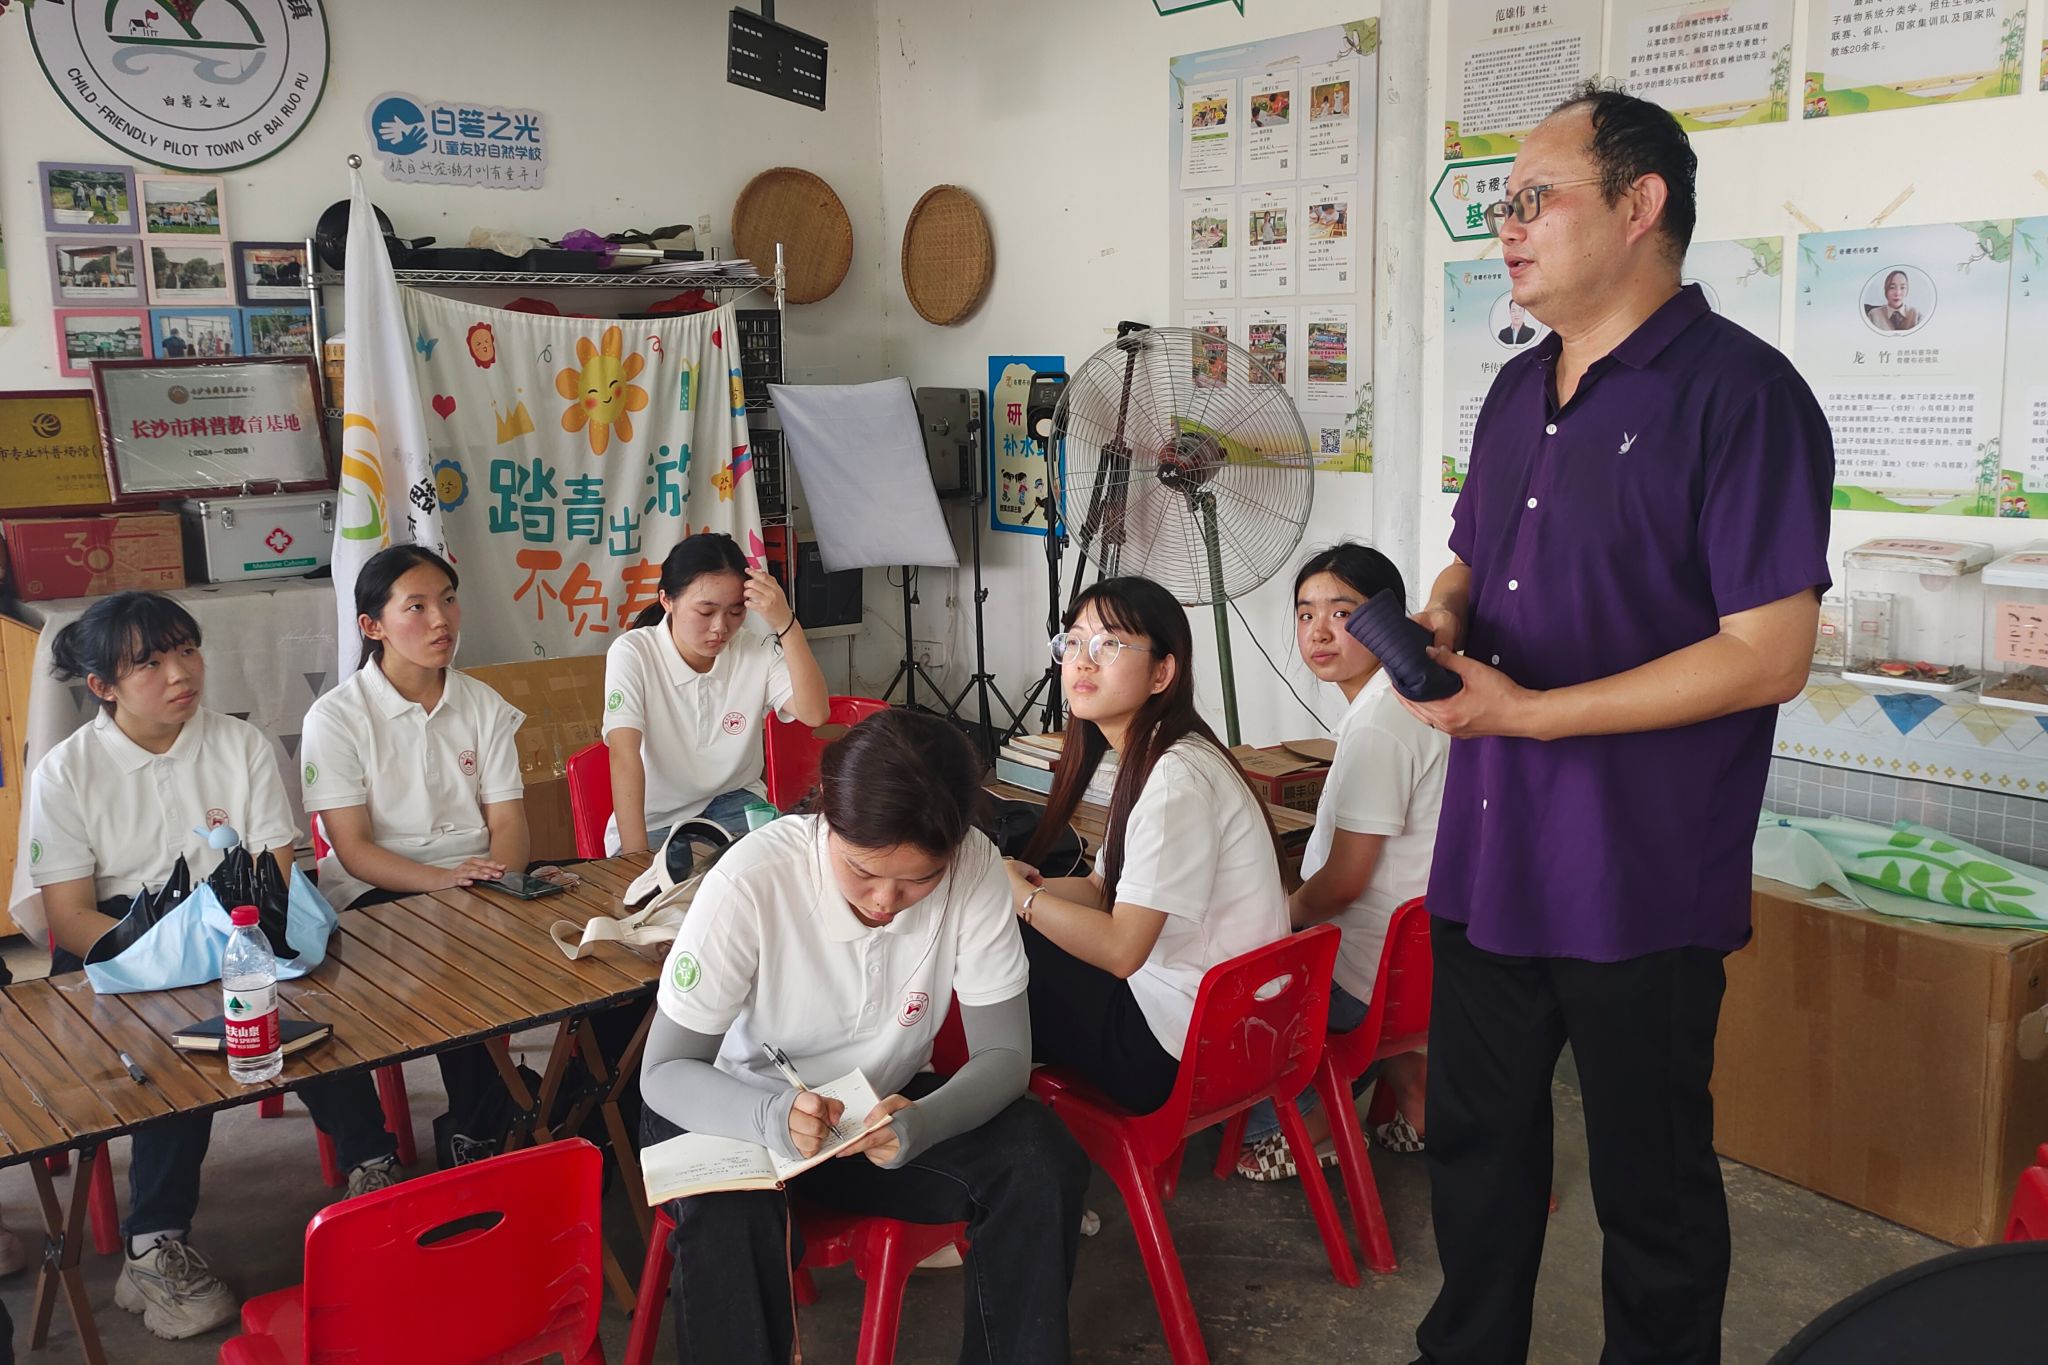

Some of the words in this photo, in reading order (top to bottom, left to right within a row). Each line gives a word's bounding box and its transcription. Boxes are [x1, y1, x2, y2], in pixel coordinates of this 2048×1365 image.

[1830, 41, 1885, 57] 教练20余年。
[67, 67, 158, 148] CHILD-FRIENDLY
[163, 139, 200, 157] PILOT
[205, 139, 245, 158] TOWN
[247, 130, 264, 146] OF
[263, 115, 285, 136] BAI
[281, 94, 303, 119] RUO
[297, 72, 310, 91] PU
[163, 95, 231, 110] 白箬之光
[431, 107, 541, 143] 白箬之光
[431, 139, 542, 161] 儿童友好自然学校
[1465, 202, 1485, 229] 基
[1852, 350, 1866, 365] 龙
[1878, 350, 1892, 365] 竹
[130, 413, 302, 440] 长沙市科普教育基地
[1006, 403, 1023, 426] 研
[489, 443, 692, 557] 踏青出游
[160, 571, 174, 581] F4
[514, 546, 668, 637] 不负春
